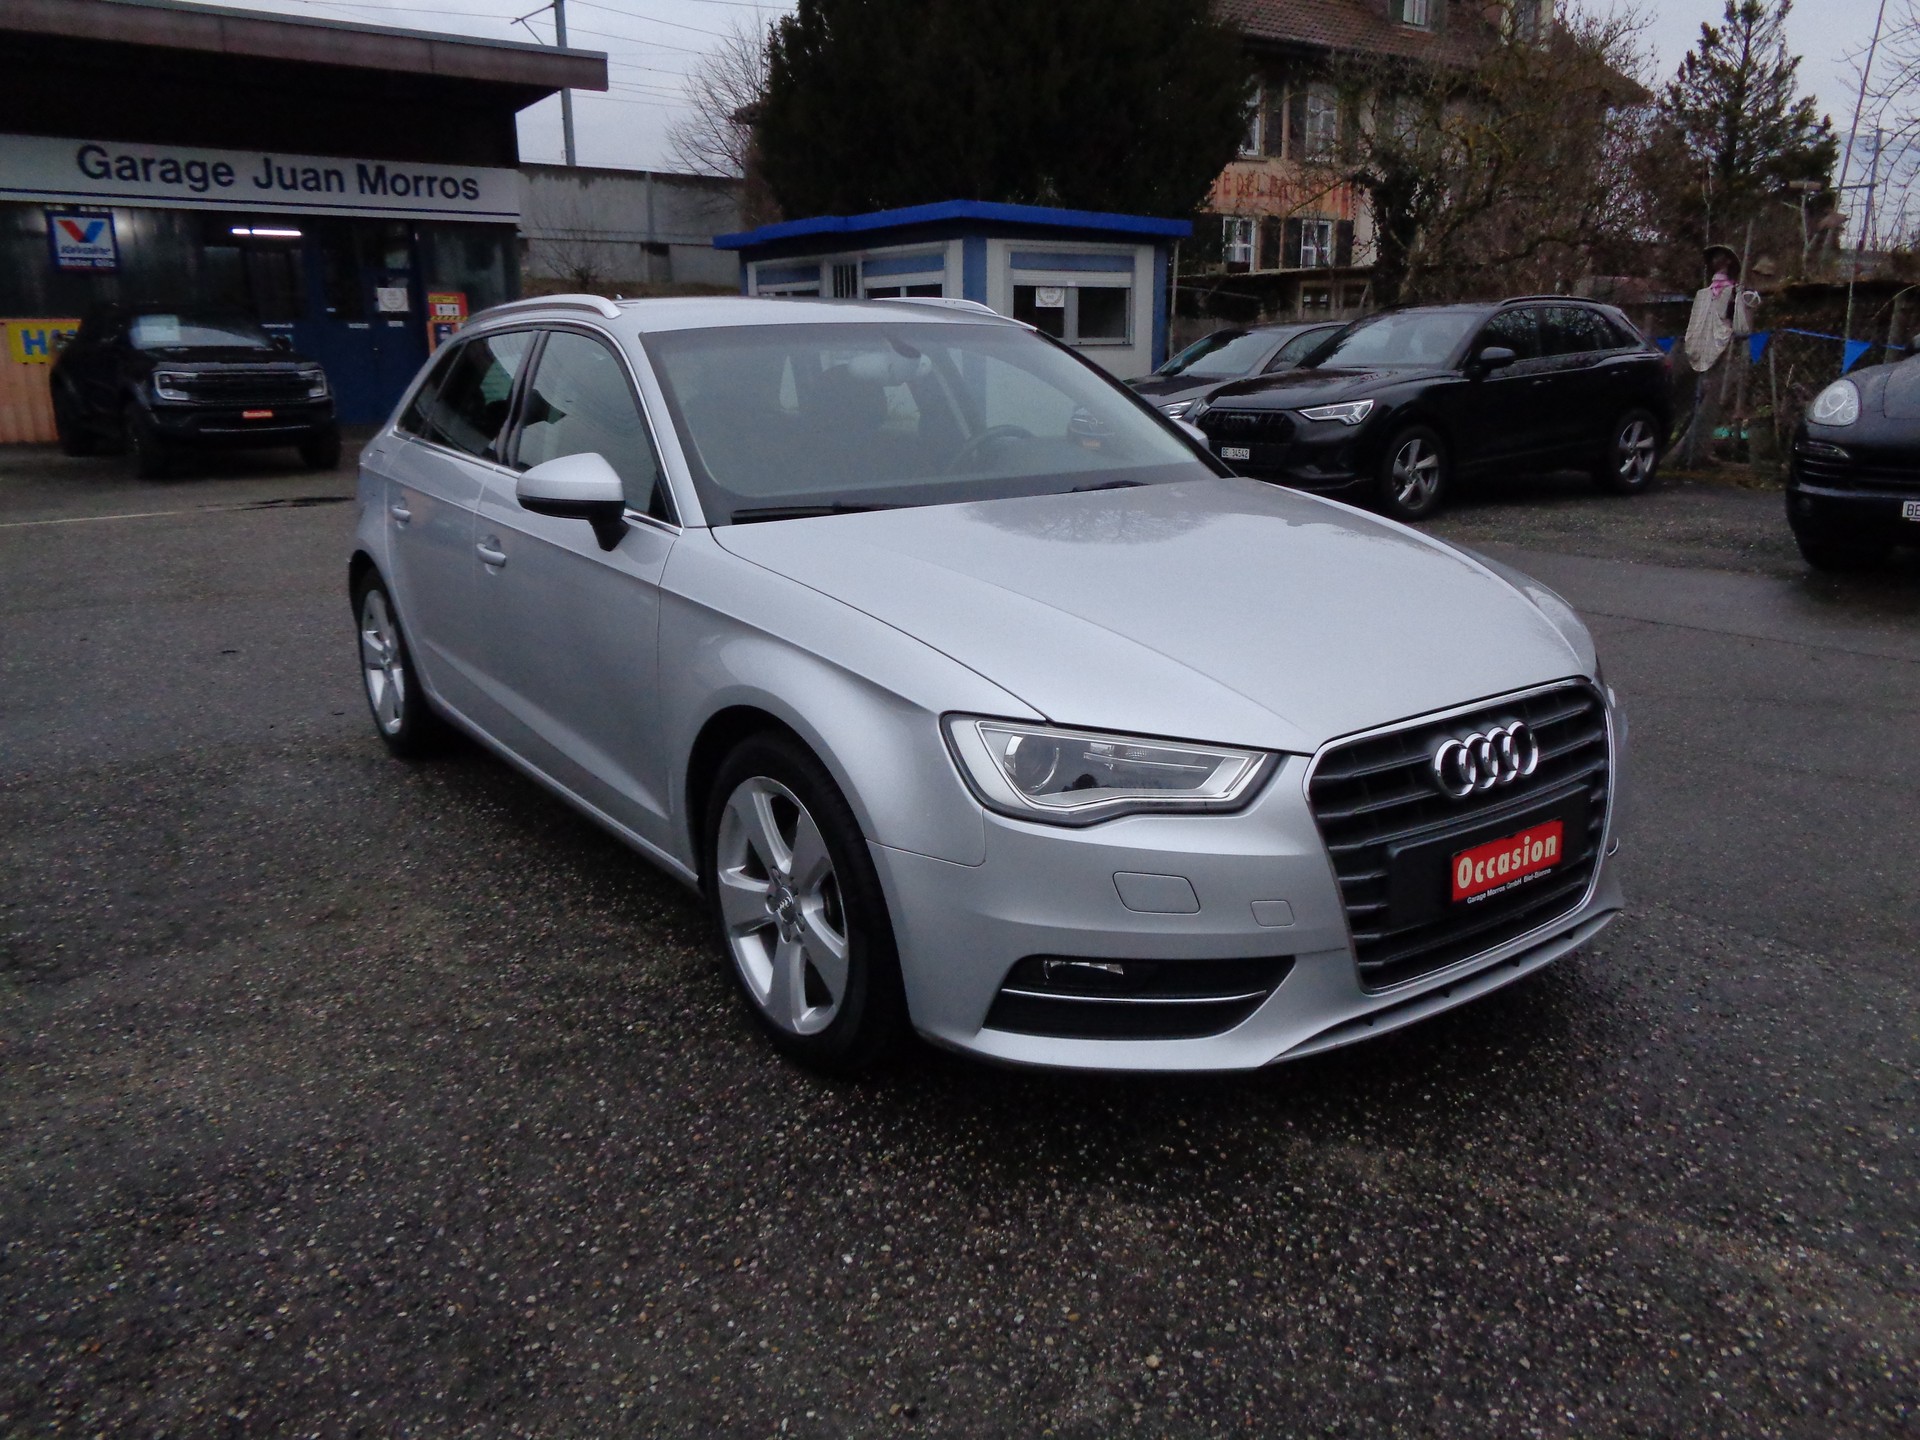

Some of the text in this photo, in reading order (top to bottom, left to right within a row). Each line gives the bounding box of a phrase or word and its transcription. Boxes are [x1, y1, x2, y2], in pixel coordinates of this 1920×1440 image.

[76, 144, 480, 201] Garage Juan Morros
[1457, 835, 1556, 889] Occasion
[1467, 892, 1487, 904] Garage
[1506, 878, 1522, 889] GmbH
